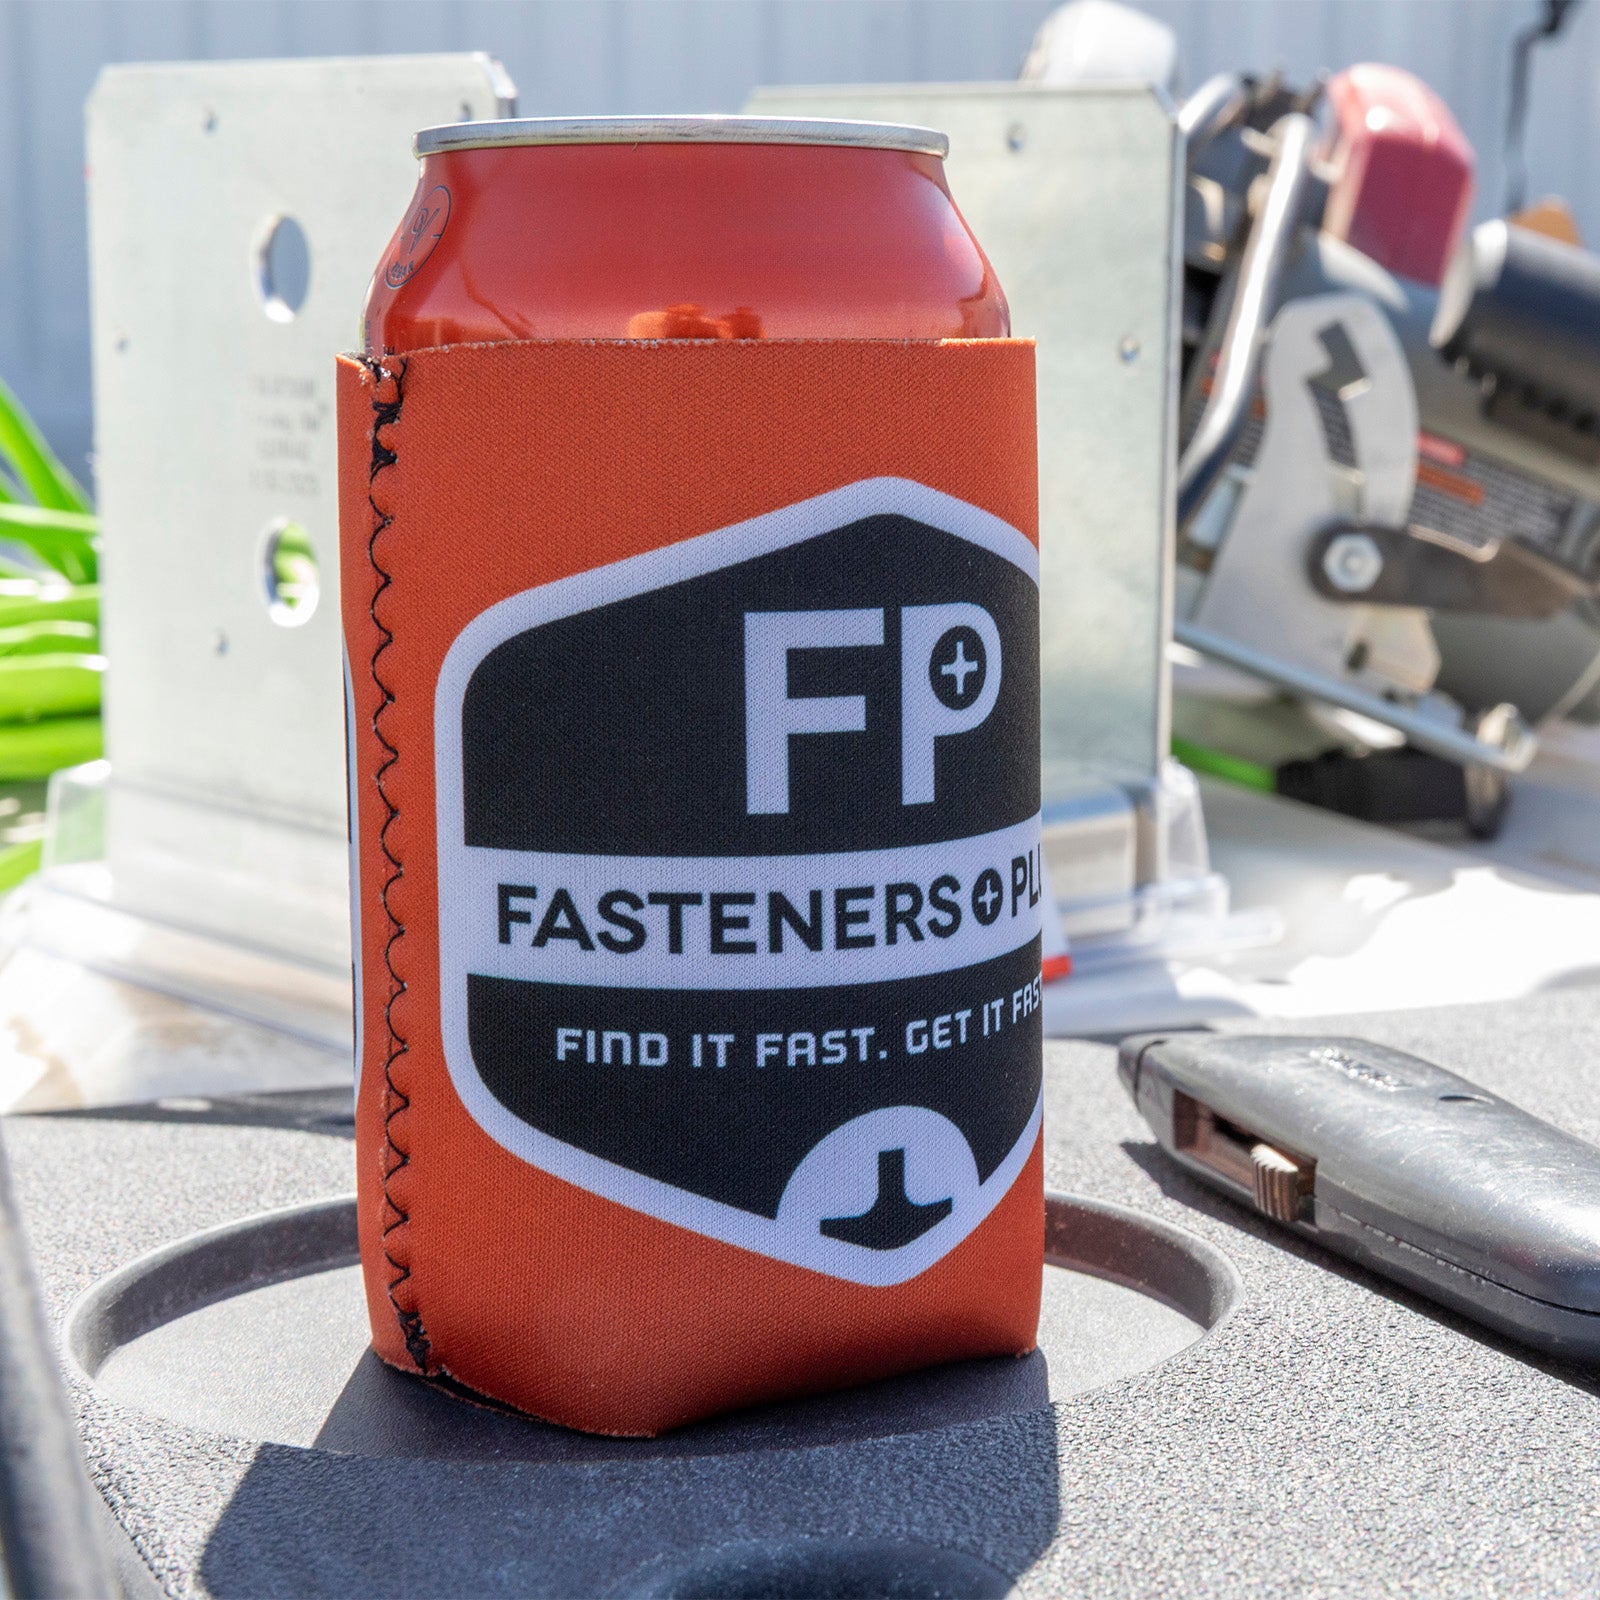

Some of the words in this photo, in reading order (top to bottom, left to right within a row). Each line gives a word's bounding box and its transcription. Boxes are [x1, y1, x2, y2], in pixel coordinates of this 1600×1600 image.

[744, 602, 1001, 814] FP
[498, 873, 962, 954] FASTENERS
[556, 1027, 669, 1067] FIND
[692, 1034, 735, 1068] IT
[756, 1026, 887, 1068] FAST.
[906, 1009, 972, 1055] GET
[983, 998, 1004, 1036] IT
